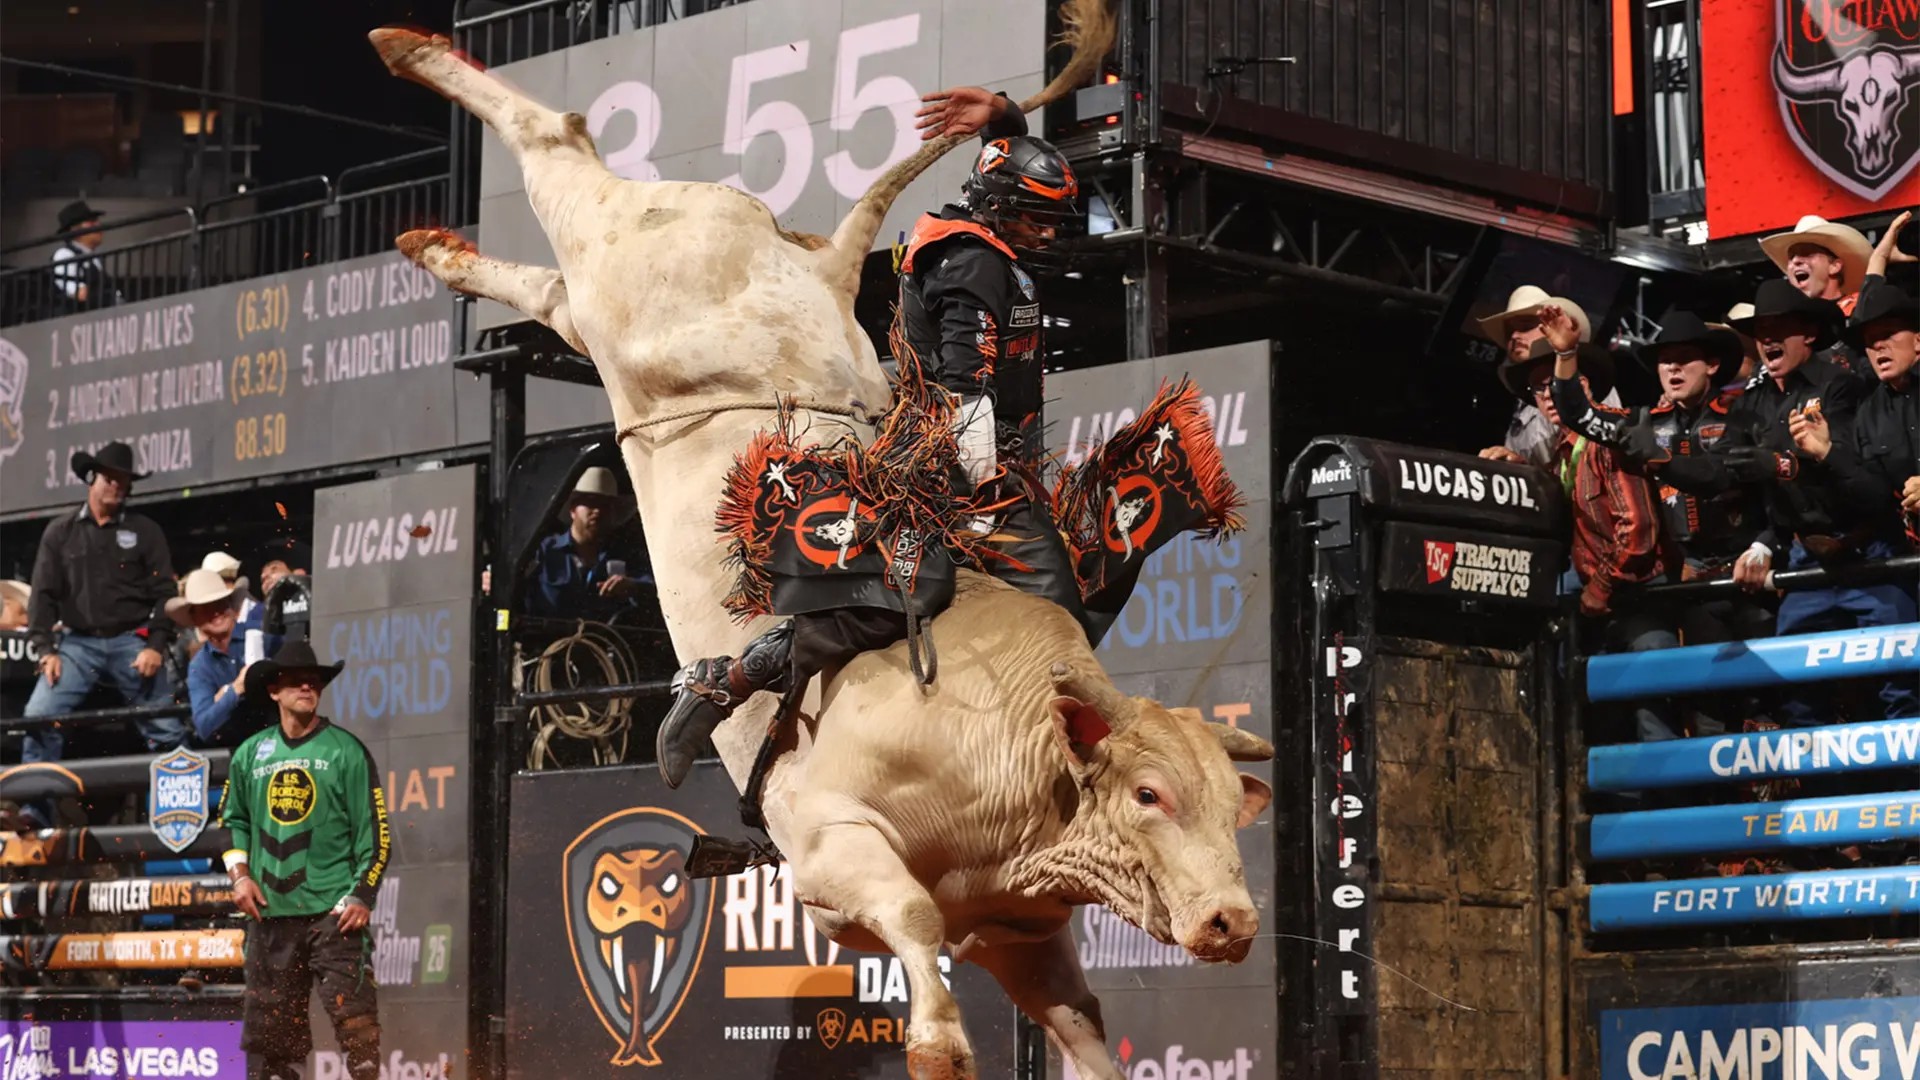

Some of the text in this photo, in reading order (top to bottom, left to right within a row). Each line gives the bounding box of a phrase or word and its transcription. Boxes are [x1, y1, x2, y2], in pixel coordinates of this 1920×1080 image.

[303, 261, 436, 322] 4. CODY JESUS
[51, 284, 290, 368] 1. SILVANO ALVES (6.31)
[302, 320, 450, 387] 5. KAIDEN LOUD
[47, 347, 287, 429] 2. ANDERSON DE OLIVEIRA (3.32)
[138, 428, 192, 475] SOUZA
[234, 412, 287, 461] 88.50
[1312, 464, 1352, 485] Merit
[1400, 459, 1486, 502] LUCAS
[327, 507, 458, 569] LUCAS OIL
[1426, 541, 1449, 577] TSC
[1455, 541, 1532, 574] TRACTOR
[1451, 566, 1511, 595] SUPPLY
[329, 607, 452, 662] CAMPING
[1097, 573, 1242, 651] ORLD
[1804, 633, 1919, 668] PBR
[332, 657, 451, 722] WORLD
[1709, 726, 1876, 776] CAMPING
[388, 766, 456, 813] IAT
[1326, 646, 1366, 999] Priefert
[1743, 809, 1840, 837] TEAM
[89, 880, 150, 914] RATTLER
[151, 880, 193, 907] DAYS
[1653, 887, 1740, 913] FORT
[1755, 879, 1887, 908] WORTH,
[67, 936, 235, 963] FORT WORTH, TX 2024
[427, 935, 448, 973] 25
[859, 956, 951, 1003] DAS
[724, 1025, 790, 1041] PRESENTED
[797, 1026, 812, 1040] BY
[1627, 1022, 1881, 1080] CAMPING
[69, 1047, 119, 1076] LAS
[122, 1047, 219, 1077] VEGAS
